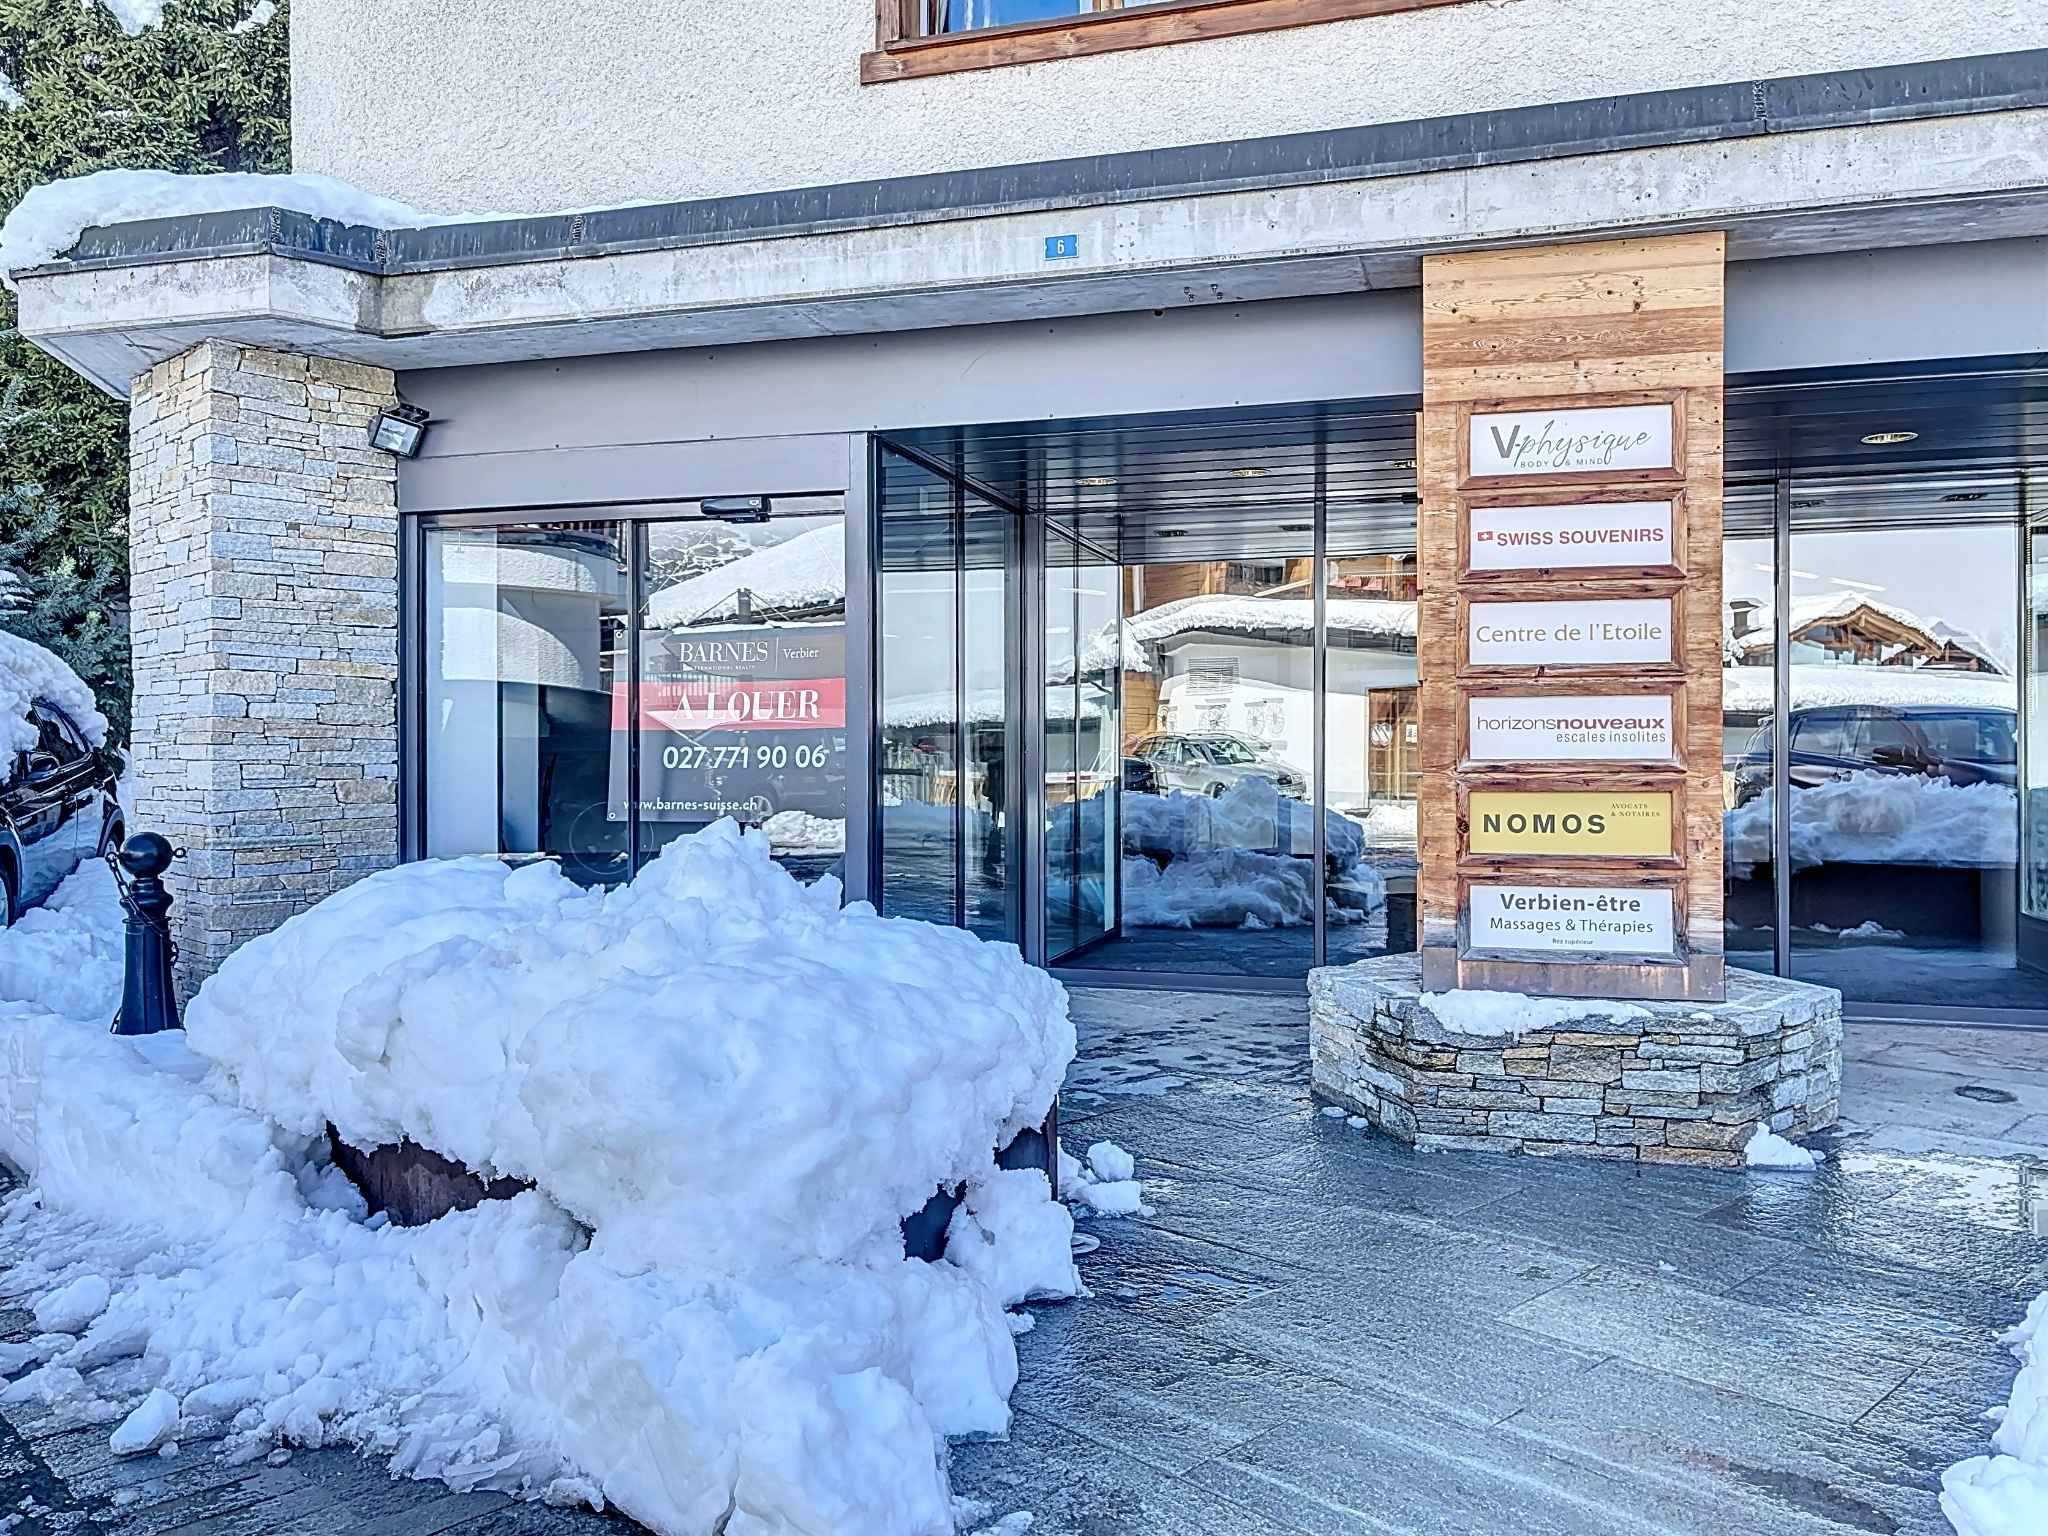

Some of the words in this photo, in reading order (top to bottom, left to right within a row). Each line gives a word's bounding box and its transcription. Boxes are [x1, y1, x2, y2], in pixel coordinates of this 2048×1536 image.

[1057, 239, 1065, 255] 6
[1520, 461, 1549, 469] BODY
[1576, 457, 1604, 466] MIND
[1497, 531, 1553, 547] SWISS
[1559, 528, 1664, 544] SOUVENIRS
[1476, 626, 1546, 643] Centre
[1554, 624, 1581, 641] de
[1589, 623, 1662, 641] l'Etoile
[679, 641, 769, 662] BARNES
[783, 648, 820, 659] Verbier
[673, 692, 695, 720] A
[707, 689, 820, 720] LOUER
[1477, 715, 1665, 731] horizonsnouveaux
[1556, 732, 1605, 743] escales
[1609, 731, 1666, 743] insolites
[663, 746, 707, 769] 027
[713, 746, 748, 769] 771
[757, 745, 786, 769] 90
[795, 744, 826, 768] 06
[1483, 814, 1606, 834] NOMOS
[1500, 893, 1641, 912] Verbien-être
[1490, 917, 1561, 934] Massages
[1565, 919, 1576, 931] &
[1579, 919, 1653, 935] Thérapies
